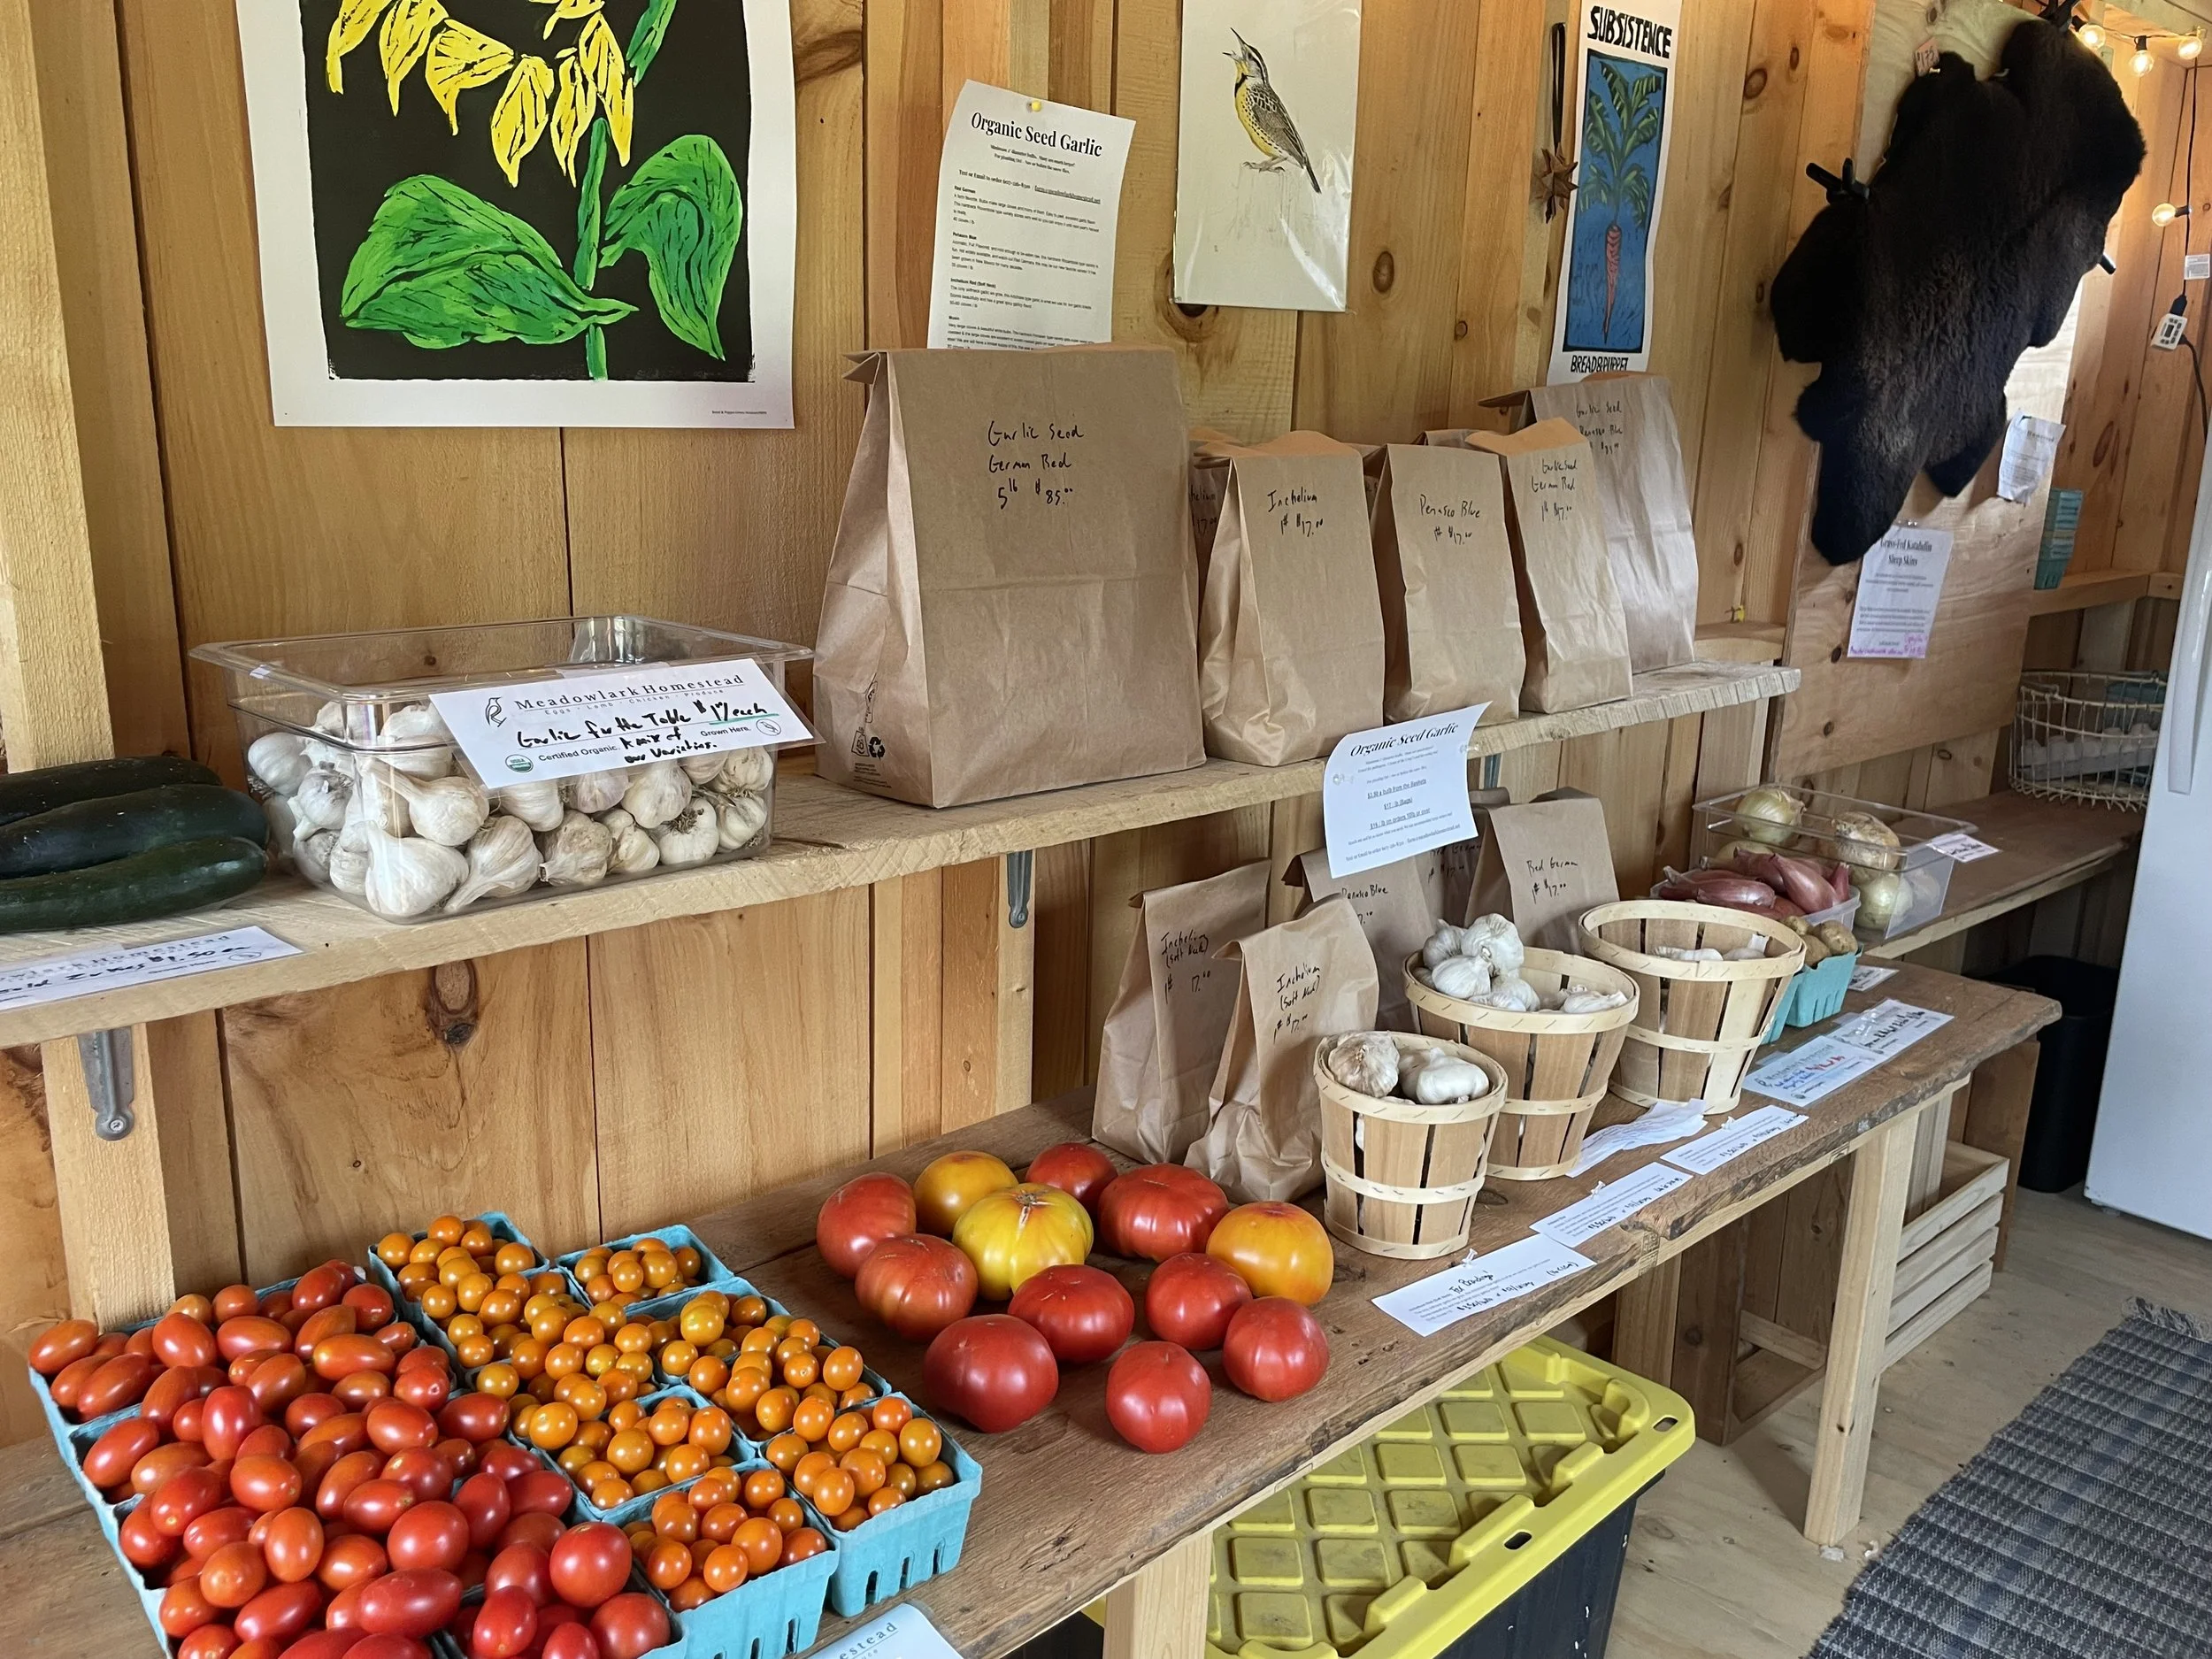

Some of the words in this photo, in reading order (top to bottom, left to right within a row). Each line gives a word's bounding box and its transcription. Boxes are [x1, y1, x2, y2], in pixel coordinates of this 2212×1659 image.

[1587, 5, 1672, 59] SUBSISTENCE
[971, 111, 1023, 139] Organic
[1025, 126, 1056, 148] Seed
[1060, 134, 1102, 157] Garlic
[987, 420, 1039, 447] Garlic
[1048, 423, 1085, 440] Seed
[989, 454, 1031, 473] German
[1041, 451, 1071, 470] Red
[1561, 476, 1575, 491] Red
[1267, 487, 1317, 512] Inchelium
[1461, 500, 1480, 518] Blue
[514, 687, 639, 710] Meadowlark
[642, 674, 744, 695] Homestead
[629, 695, 670, 704] Chicken
[518, 728, 581, 748] Garlic
[641, 709, 691, 726] Table
[1350, 736, 1397, 757] Organic
[1397, 729, 1426, 746] Seed
[1426, 722, 1459, 739] Garlic
[538, 750, 579, 762] Certified
[1526, 859, 1544, 878] Red
[1549, 856, 1578, 870] German
[1370, 883, 1388, 896] Blue
